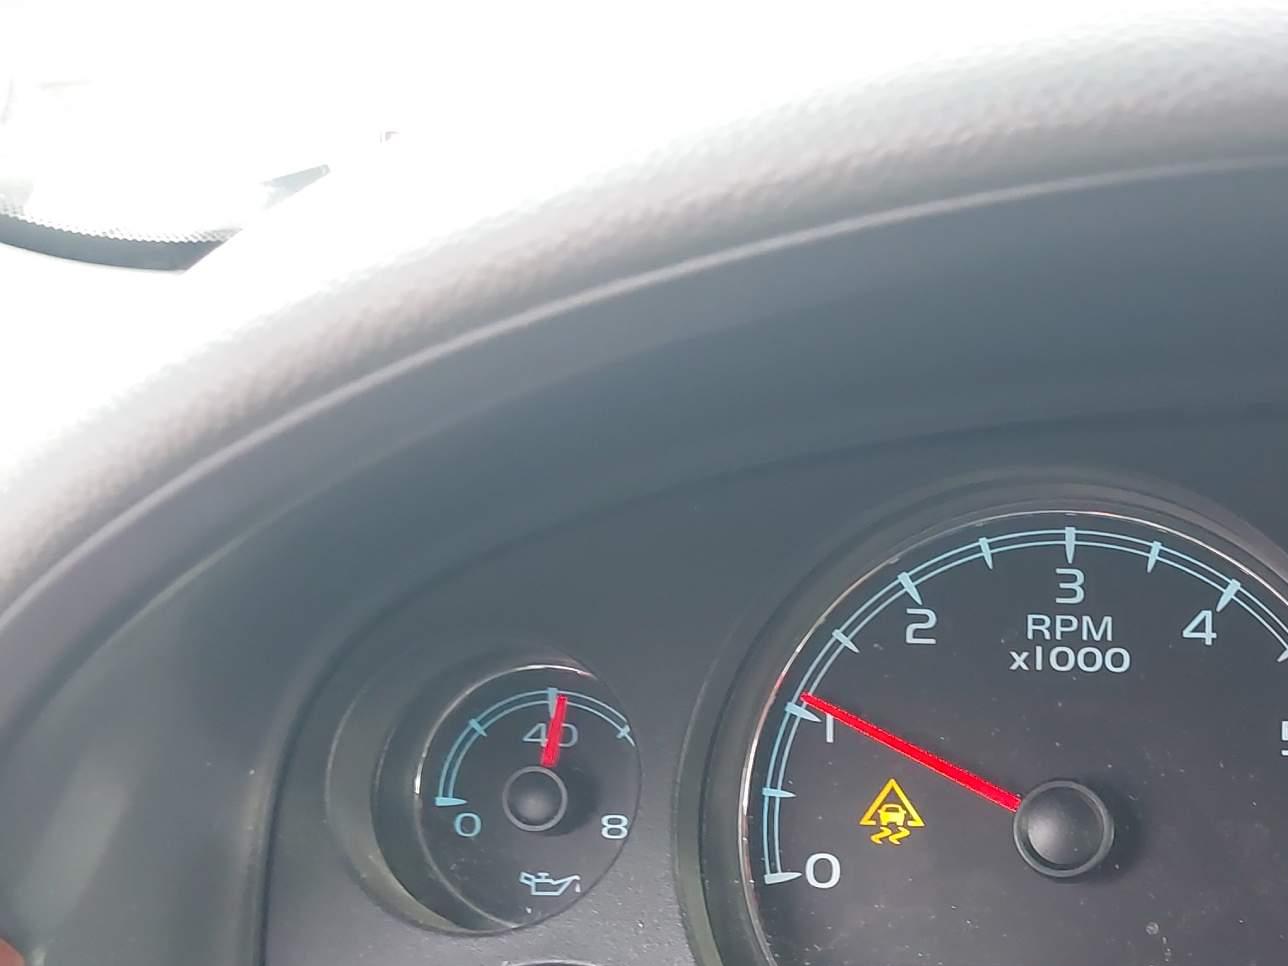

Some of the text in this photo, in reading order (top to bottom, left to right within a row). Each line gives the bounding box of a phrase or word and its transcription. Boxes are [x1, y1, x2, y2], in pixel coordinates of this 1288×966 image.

[1056, 568, 1085, 604] 3
[905, 608, 937, 645] 2
[1027, 614, 1113, 641] RPM
[1182, 609, 1217, 645] 4
[1009, 646, 1131, 673] x1000
[826, 713, 834, 743] 1
[454, 812, 481, 837] 0
[805, 852, 841, 888] 0
